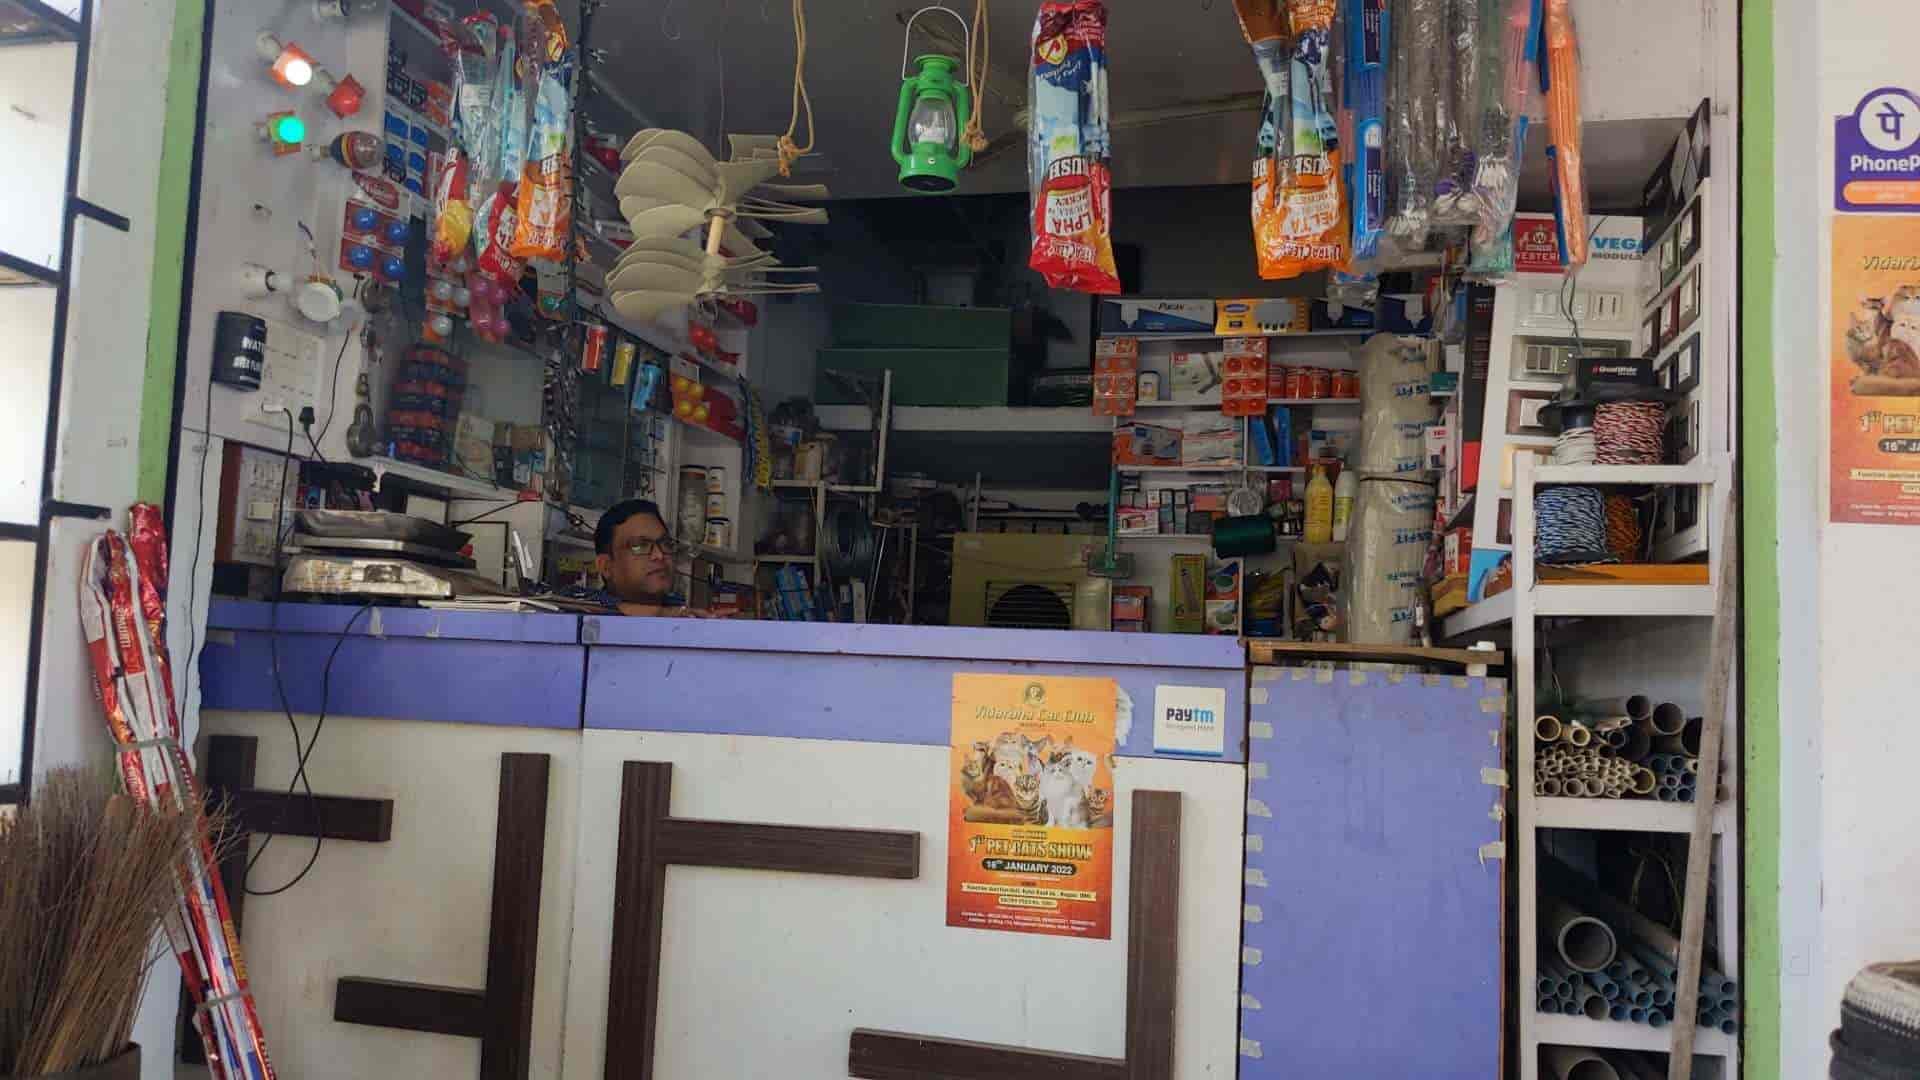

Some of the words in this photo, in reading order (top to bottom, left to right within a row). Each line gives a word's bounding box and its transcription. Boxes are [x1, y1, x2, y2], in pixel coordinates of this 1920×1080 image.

[1052, 212, 1093, 233] LPHA
[1004, 861, 1049, 873] JANUARY
[1051, 864, 1073, 875] 2022
